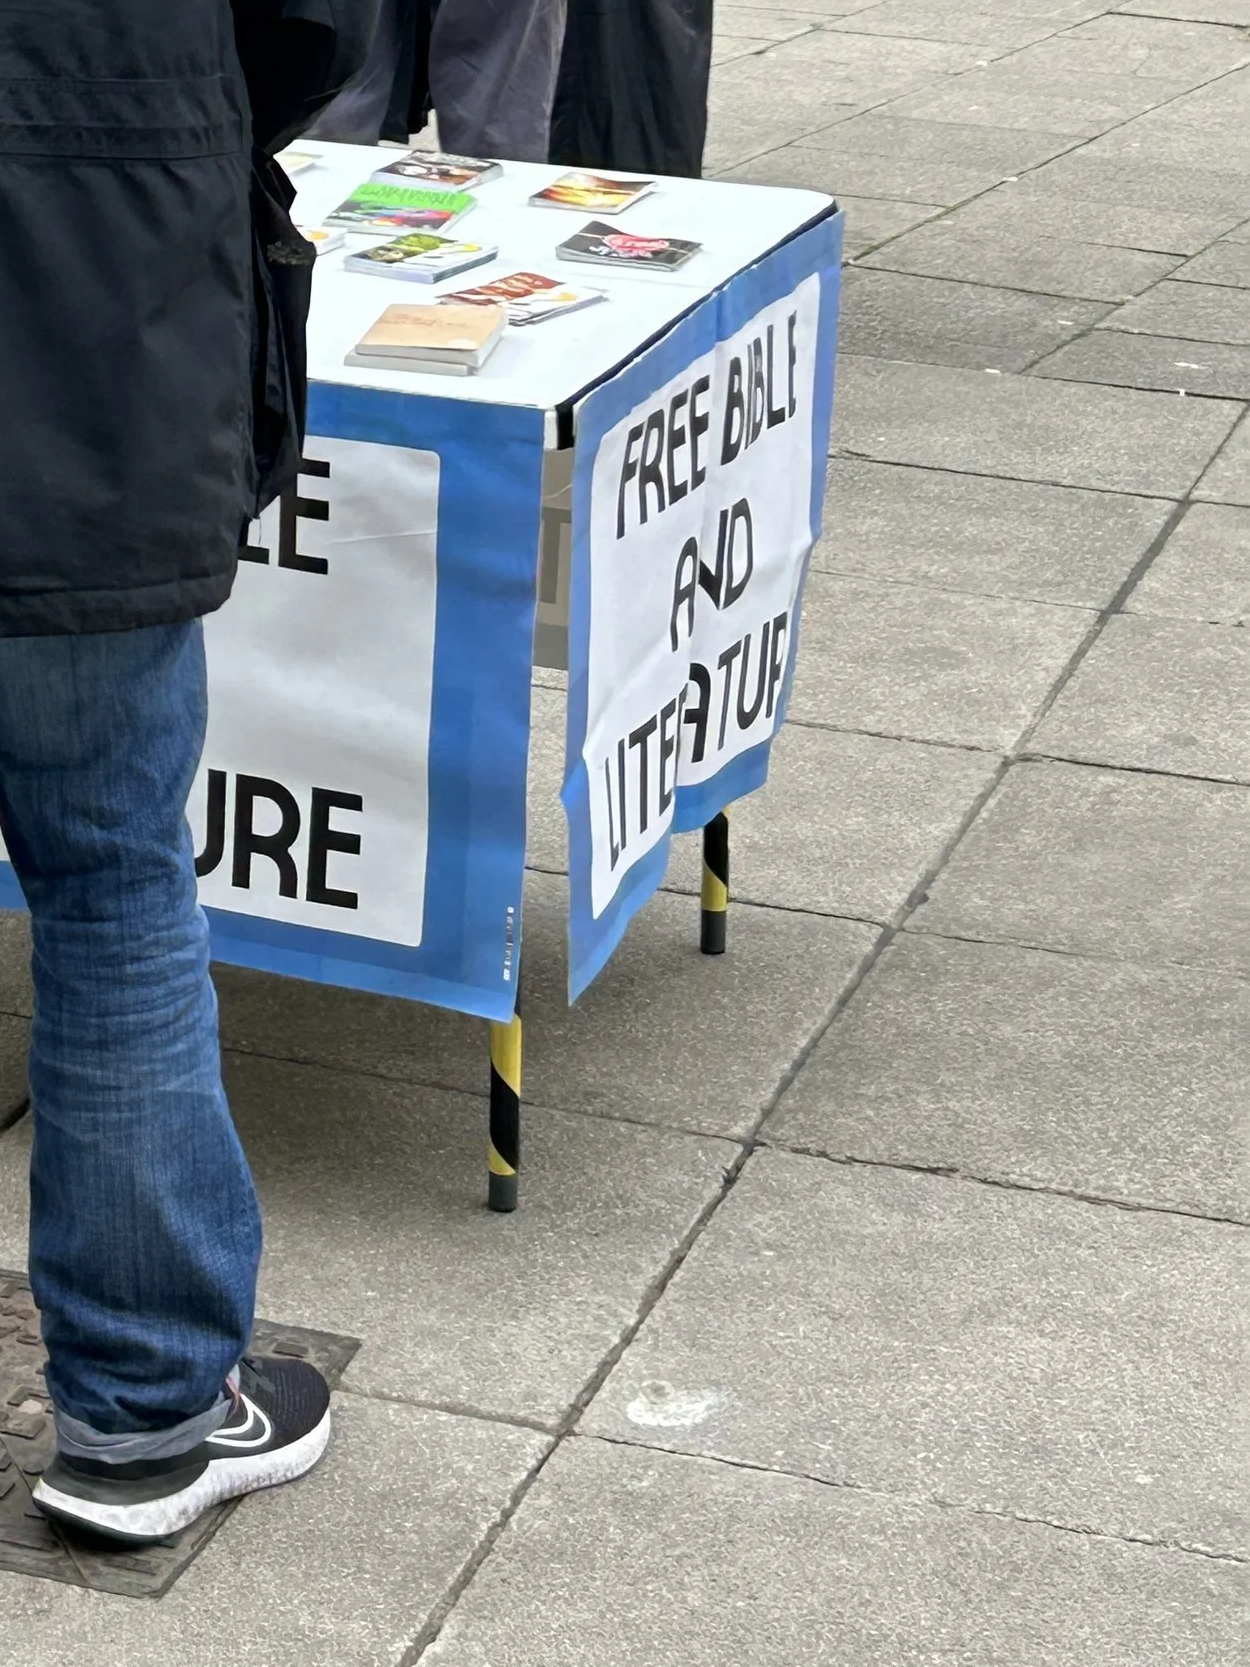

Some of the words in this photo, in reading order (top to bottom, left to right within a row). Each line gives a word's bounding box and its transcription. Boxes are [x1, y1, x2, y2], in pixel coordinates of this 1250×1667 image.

[615, 374, 711, 541] FREE
[719, 310, 797, 466] BIBLE
[670, 497, 754, 653] AND
